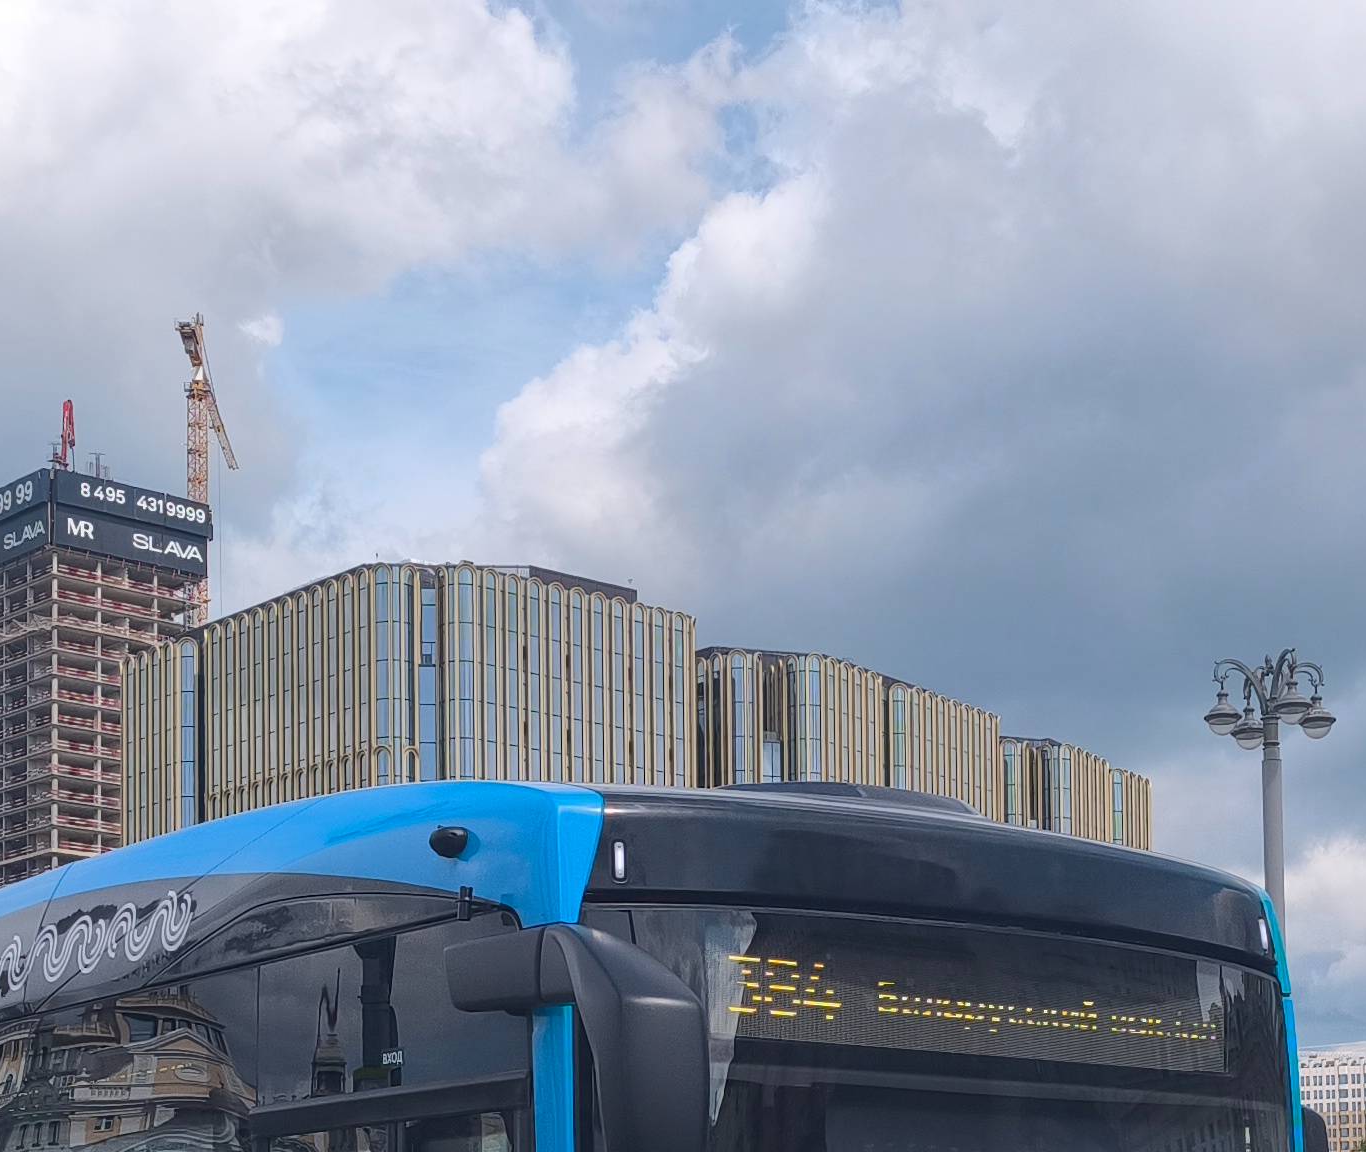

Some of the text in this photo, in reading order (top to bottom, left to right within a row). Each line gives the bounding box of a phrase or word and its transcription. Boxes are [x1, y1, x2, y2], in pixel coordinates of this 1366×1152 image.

[15, 480, 33, 505] 99
[80, 482, 91, 498] 8
[93, 485, 126, 504] 495
[3, 519, 45, 550] SLAVA
[67, 517, 94, 540] MR
[132, 533, 204, 563] SLAVA
[382, 1050, 403, 1065] ВХОД
